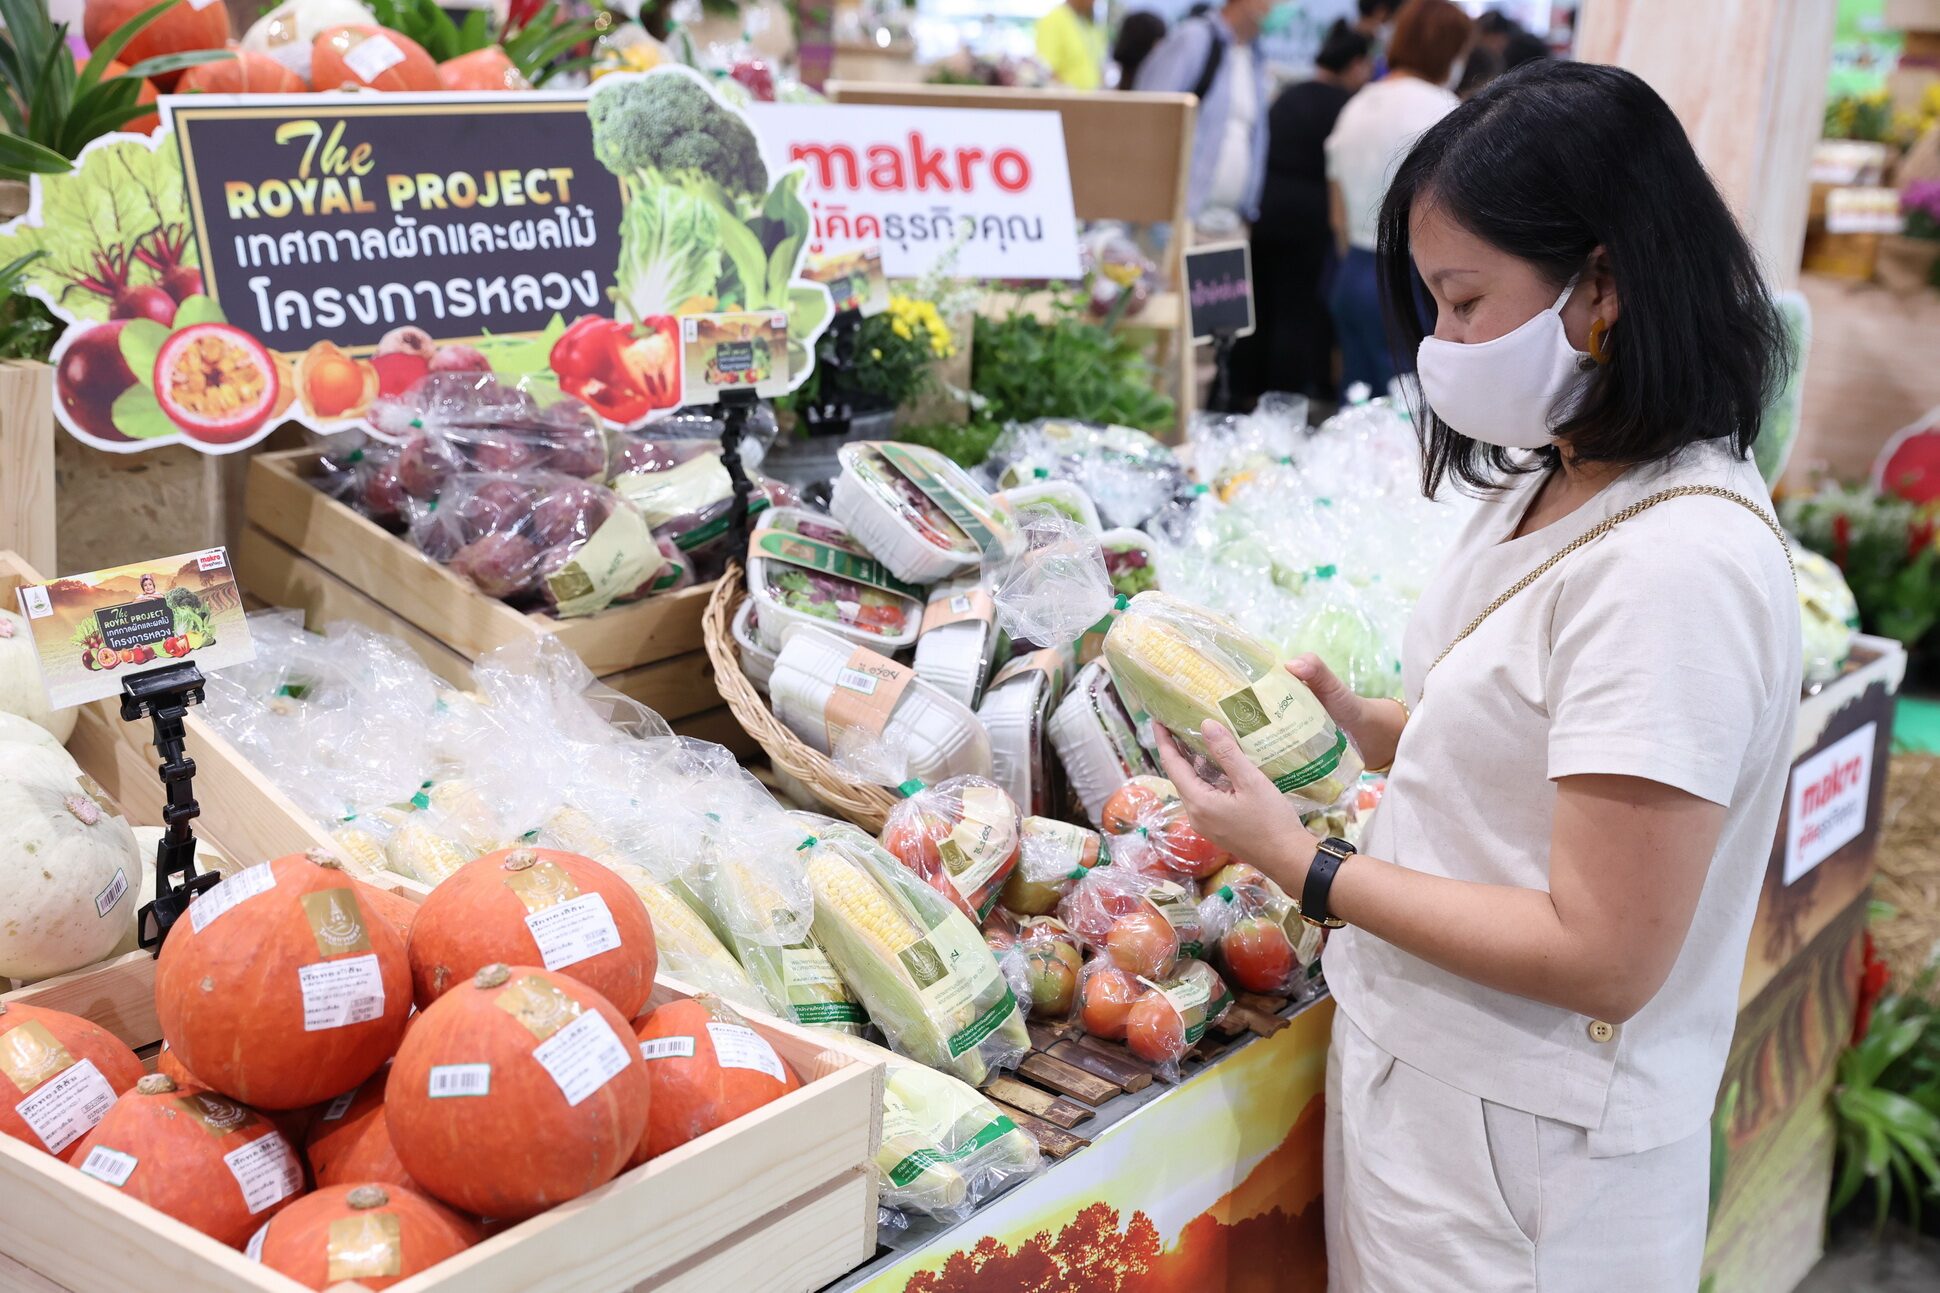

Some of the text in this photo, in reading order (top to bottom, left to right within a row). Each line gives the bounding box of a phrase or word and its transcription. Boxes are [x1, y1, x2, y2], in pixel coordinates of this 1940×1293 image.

[275, 119, 376, 179] The
[789, 131, 1032, 192] makro
[224, 167, 575, 220] ROYAL PROJECT
[234, 204, 598, 268] เทศกาลผักและผลไม้
[248, 269, 600, 333] โครงการหลวง
[200, 555, 222, 563] makro
[104, 609, 164, 629] ROYAL PROJECT
[110, 628, 171, 648] โครงการหลวง
[111, 608, 129, 619] The
